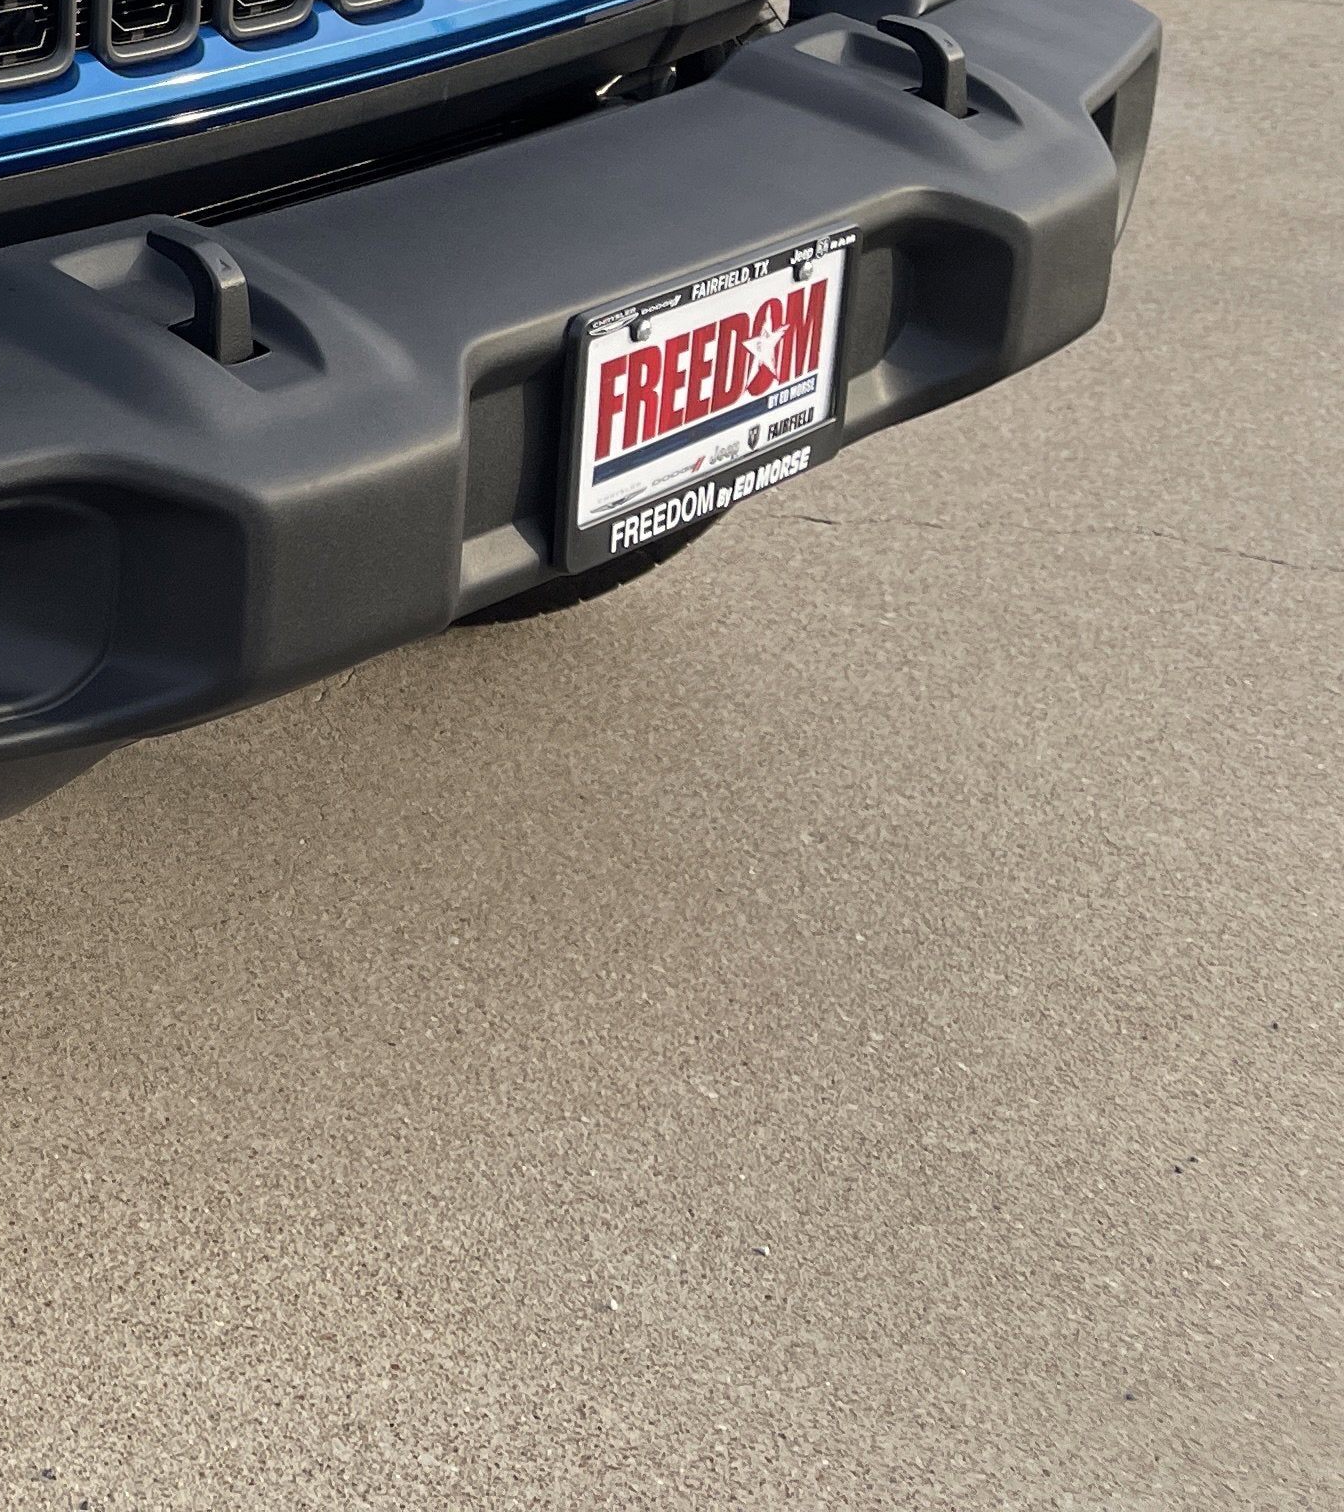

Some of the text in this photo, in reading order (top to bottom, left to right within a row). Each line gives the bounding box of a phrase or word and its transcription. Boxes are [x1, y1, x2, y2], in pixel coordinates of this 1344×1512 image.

[790, 234, 856, 265] Jeep RAM
[691, 259, 770, 301] FAIRFIELD, TX
[593, 278, 829, 463] FREEDOM
[767, 406, 815, 442] FAIRFIELD
[708, 440, 741, 466] Jeep
[610, 481, 715, 554] FREEDOM
[732, 471, 756, 501] ED
[755, 445, 811, 492] MORSE
